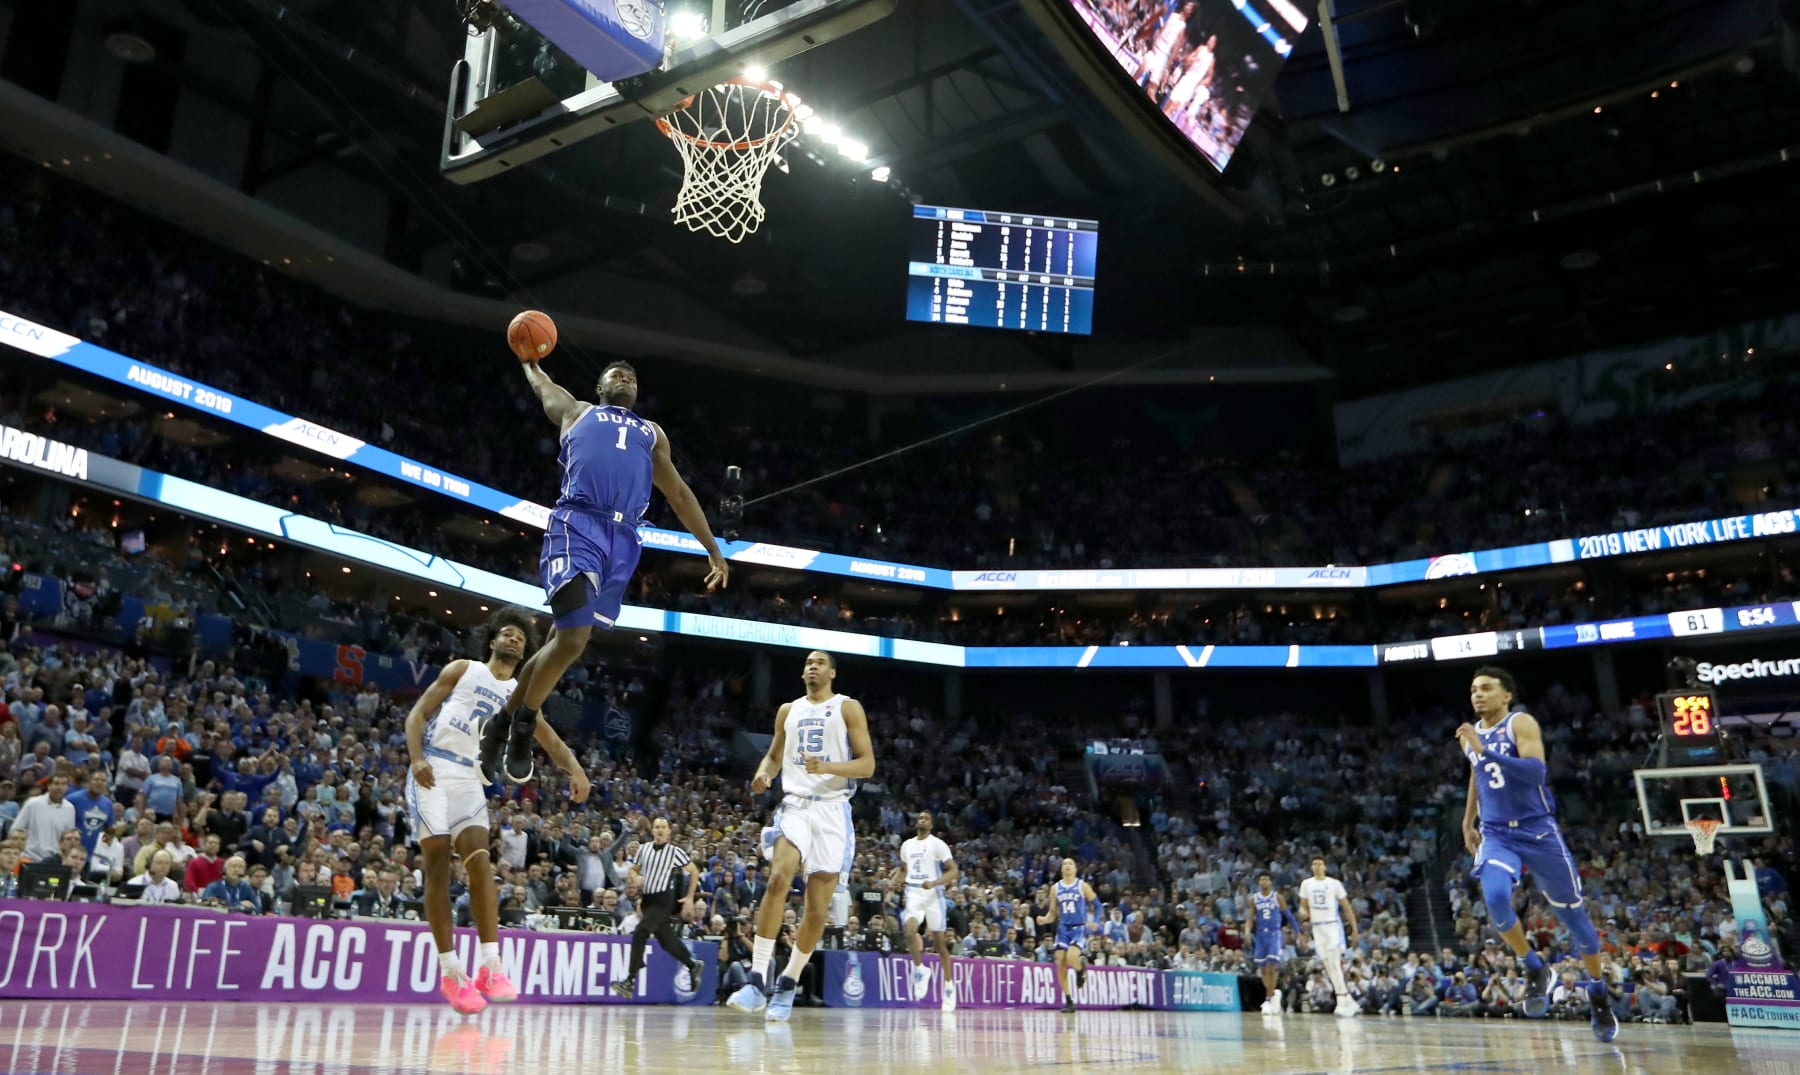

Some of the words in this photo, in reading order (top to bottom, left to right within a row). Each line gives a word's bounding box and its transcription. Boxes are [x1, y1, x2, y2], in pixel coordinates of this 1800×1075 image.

[127, 364, 193, 400] AUGUST
[194, 388, 233, 414] 2019
[293, 423, 340, 446] ACCN
[595, 412, 651, 437] DUKE
[616, 426, 628, 450] 1
[400, 460, 423, 481] WE
[423, 469, 441, 487] DO
[443, 476, 470, 497] THIS
[1578, 533, 1622, 560] 2019
[1623, 528, 1662, 554] NEW
[1663, 520, 1712, 548] YORK
[1712, 515, 1750, 542] LIFE
[1752, 510, 1796, 537] ACC
[850, 560, 896, 578] AUGUST
[897, 566, 926, 582] 2019
[974, 572, 1017, 582] ACCN
[1306, 569, 1351, 579] ACCN
[694, 615, 734, 639] NORTH
[739, 620, 798, 645] CAROLINA
[1687, 614, 1709, 631] 61
[474, 685, 505, 706] NORTH
[469, 700, 494, 722] 2
[1673, 710, 1710, 735] 28
[798, 729, 824, 753] 15
[1484, 762, 1505, 789] 3
[1062, 901, 1076, 914] 14
[131, 916, 248, 990] LIFE
[260, 922, 367, 991] ACC
[929, 961, 975, 1003] YRK
[982, 964, 1016, 1003] LIFE
[1020, 966, 1056, 1004] ACC
